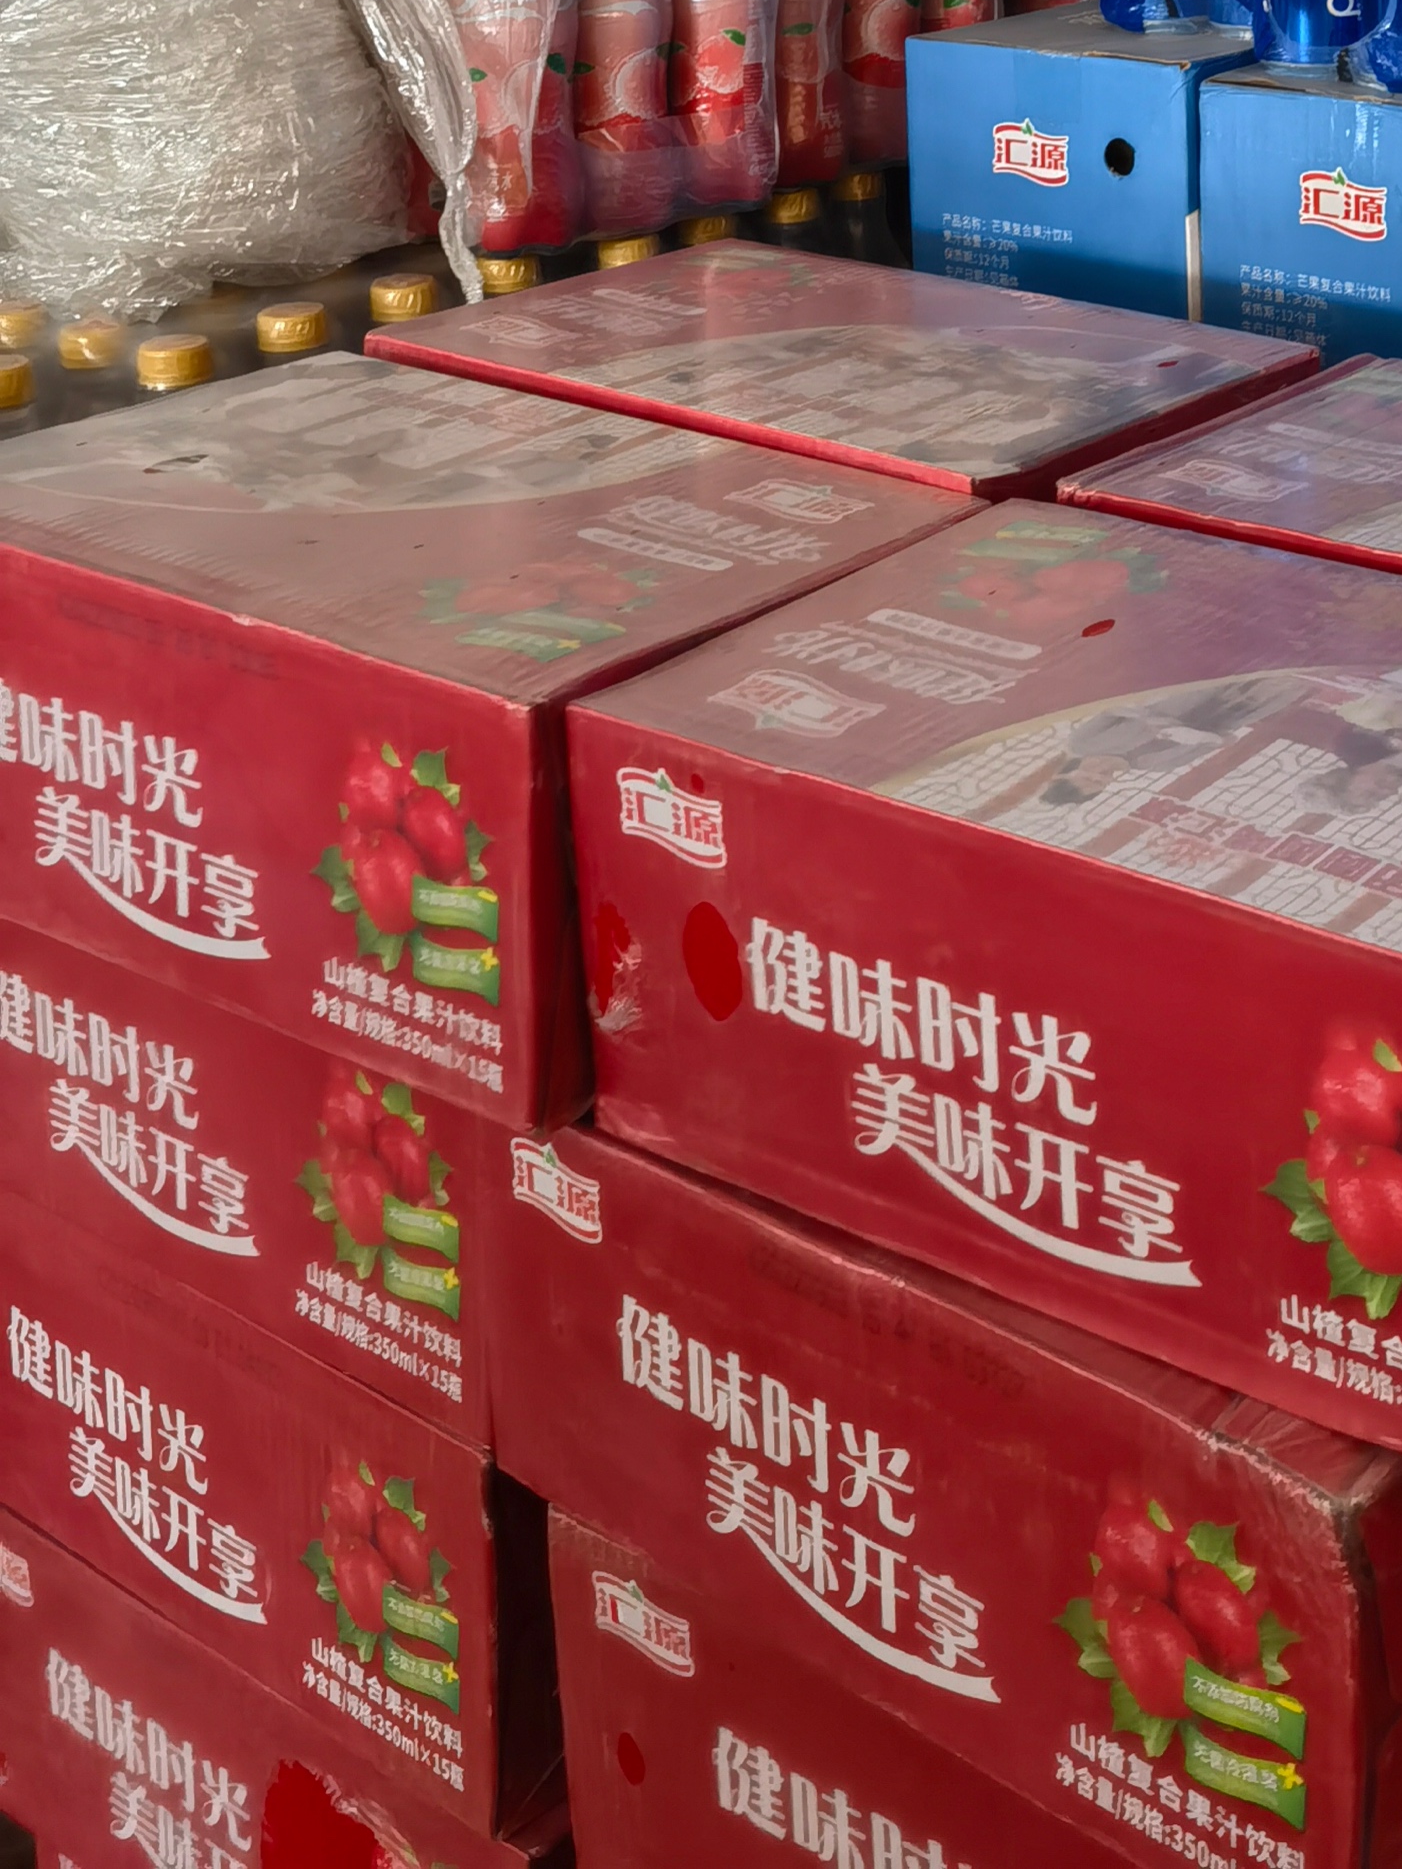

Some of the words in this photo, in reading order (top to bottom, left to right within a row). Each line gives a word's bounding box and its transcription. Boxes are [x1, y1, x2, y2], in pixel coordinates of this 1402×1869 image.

[995, 136, 1067, 172] 汇源
[1302, 186, 1385, 226] 汇源
[0, 678, 202, 827] 味时光
[620, 784, 723, 849] 汇源
[35, 787, 259, 938] 美味开享
[746, 916, 1098, 1125] 健味时光
[48, 1080, 250, 1234] 美味开享
[514, 1154, 600, 1227] 汇源
[851, 1063, 1184, 1258] 美味开享
[8, 1305, 207, 1494] 健味时光
[616, 1294, 915, 1537] 健味时光
[69, 1428, 258, 1600] 美味开享
[705, 1446, 985, 1669] 美味开享
[45, 1647, 252, 1851] 健味时光
[711, 1727, 970, 1869] 健味时
